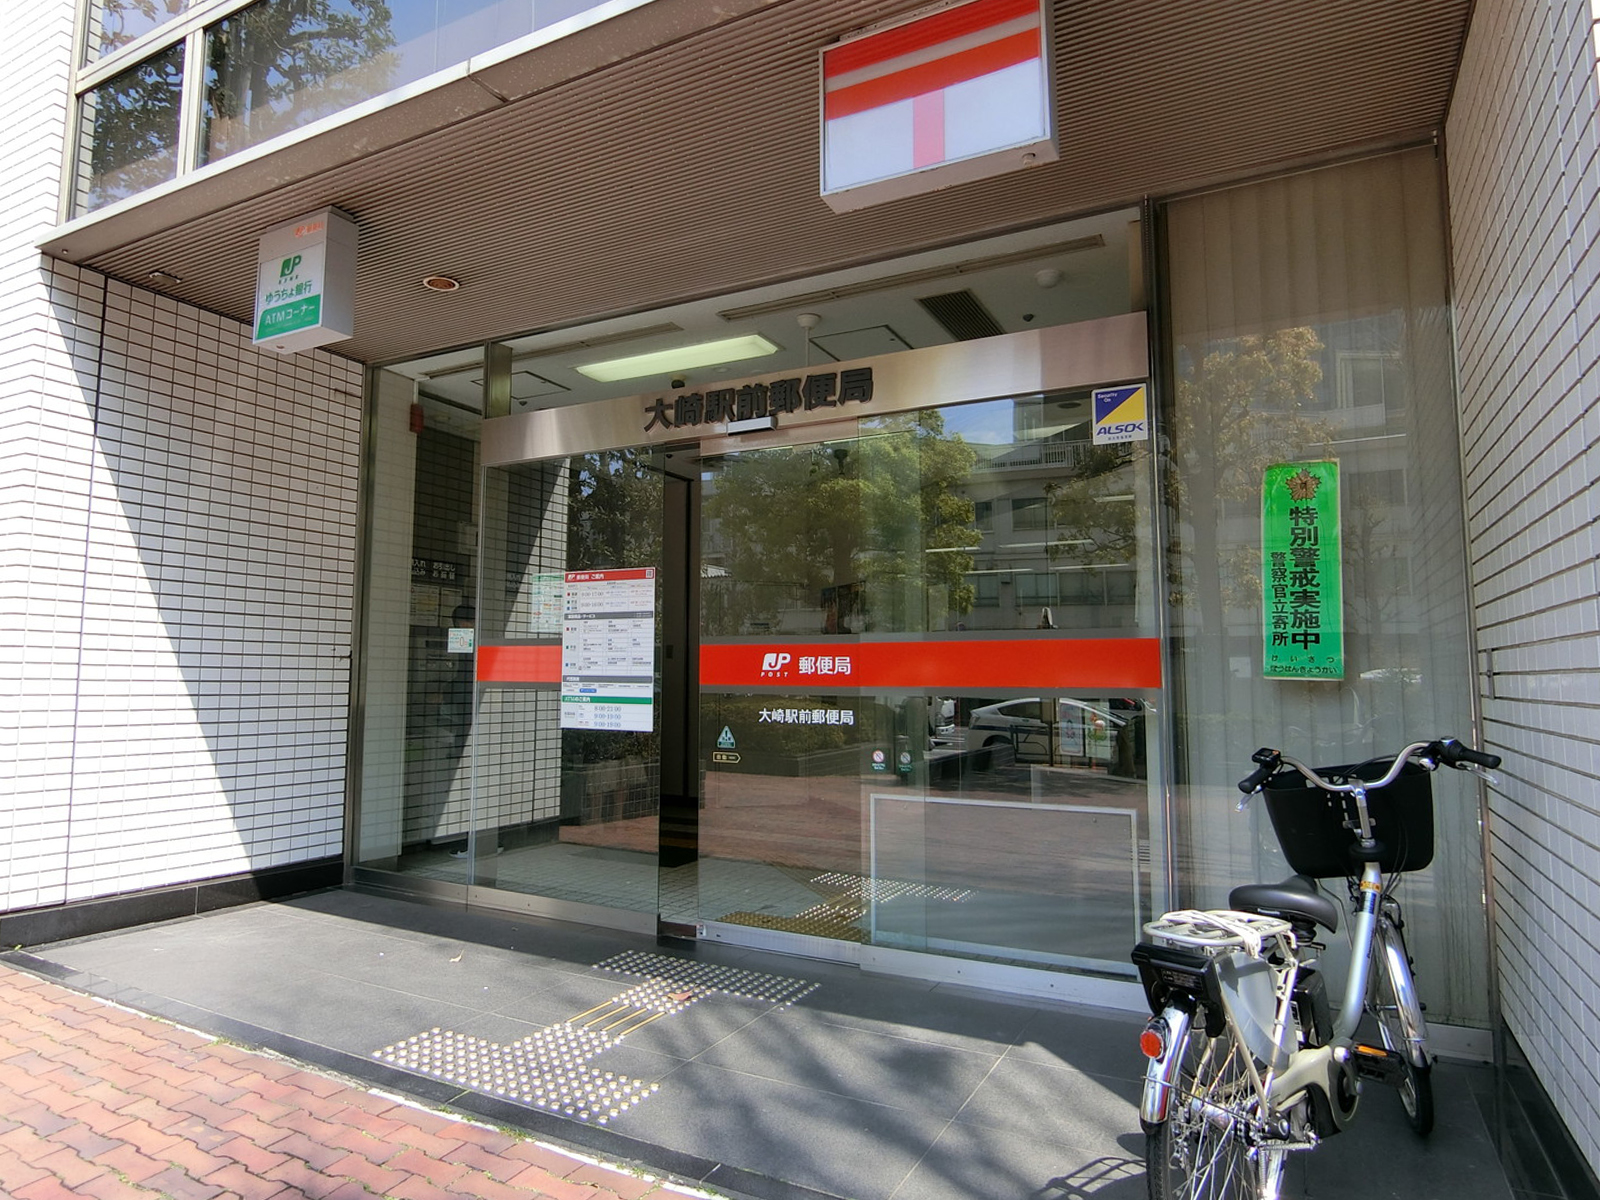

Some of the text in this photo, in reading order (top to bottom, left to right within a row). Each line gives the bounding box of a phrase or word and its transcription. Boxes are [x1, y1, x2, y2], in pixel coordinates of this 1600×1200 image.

[265, 280, 312, 304] ゆうちょ銀行
[265, 305, 315, 325] ATMコーナー
[643, 367, 874, 432] 大崎駅前郵便局
[1097, 423, 1144, 435] ALSOK
[1288, 505, 1321, 651] 特別警戒実施中
[1270, 550, 1289, 648] 警察官立寄所
[798, 656, 852, 675] 郵便局
[758, 708, 855, 726] 大崎駅前郵便局
